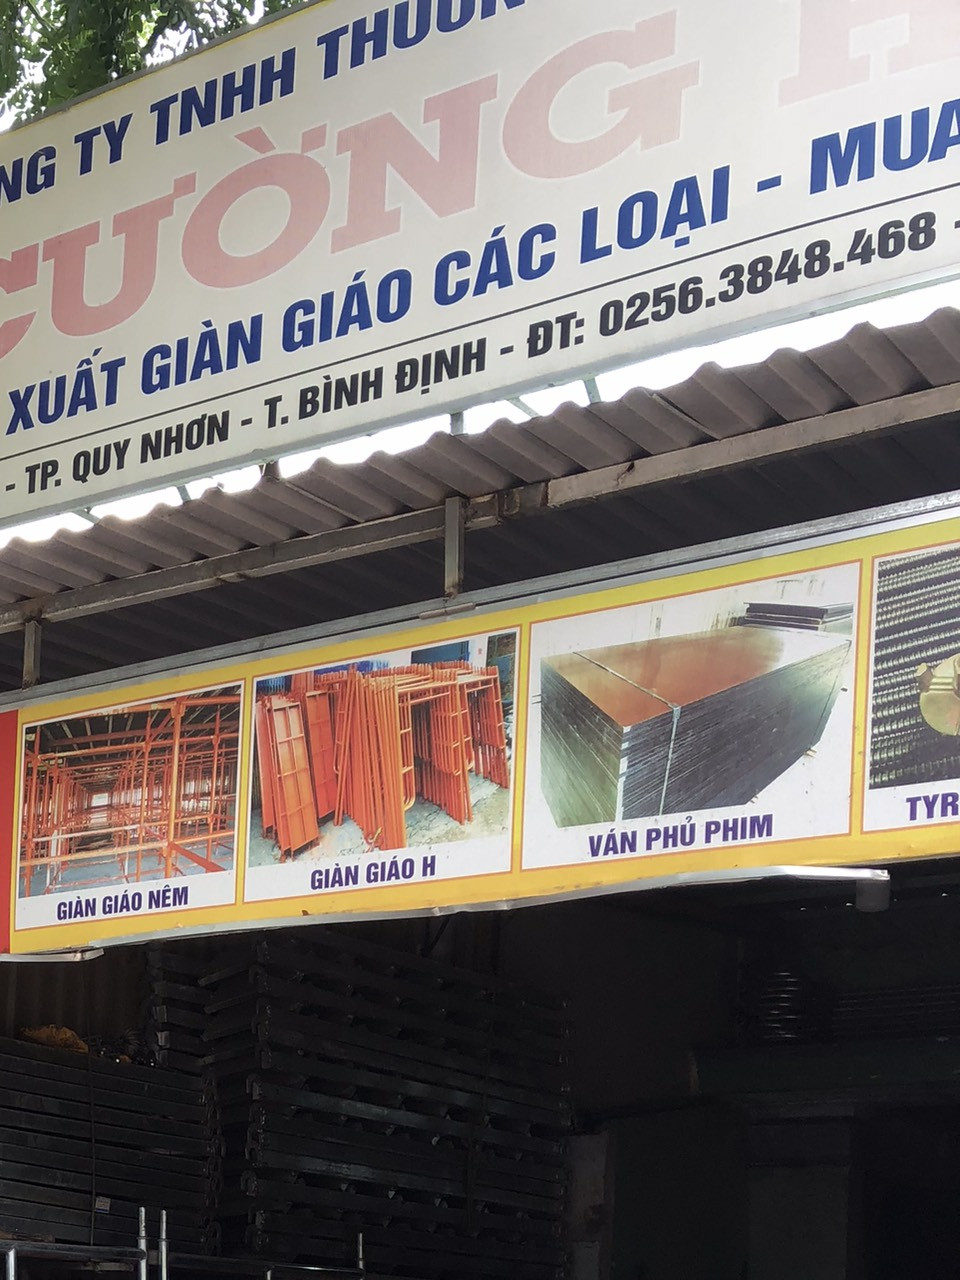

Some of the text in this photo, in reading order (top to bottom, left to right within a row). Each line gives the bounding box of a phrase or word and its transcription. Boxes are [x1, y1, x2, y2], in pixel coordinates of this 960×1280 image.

[74, 113, 133, 176] TY
[150, 48, 296, 145] TNHH
[5, 347, 126, 435] XUẤT
[142, 314, 263, 394] GIÀN
[282, 269, 412, 352] GIÁO
[434, 223, 557, 305] CÁC
[580, 165, 731, 264] LOẠI
[809, 98, 960, 195] MUA
[26, 459, 62, 493] TP.
[72, 438, 132, 483] QUY
[140, 410, 230, 464] NHƠN
[264, 395, 289, 428] T.
[298, 367, 383, 420] BÌNH
[395, 338, 487, 395] ĐỊNH
[527, 311, 585, 358] ĐT:
[599, 212, 935, 337] 0256.3848.468
[906, 792, 959, 821] TYR
[589, 814, 773, 857] VÁN PHỦ PHIM
[311, 855, 436, 890] GIÀN GIÁO H
[57, 884, 188, 920] GIÀN GIÁO NÊM
